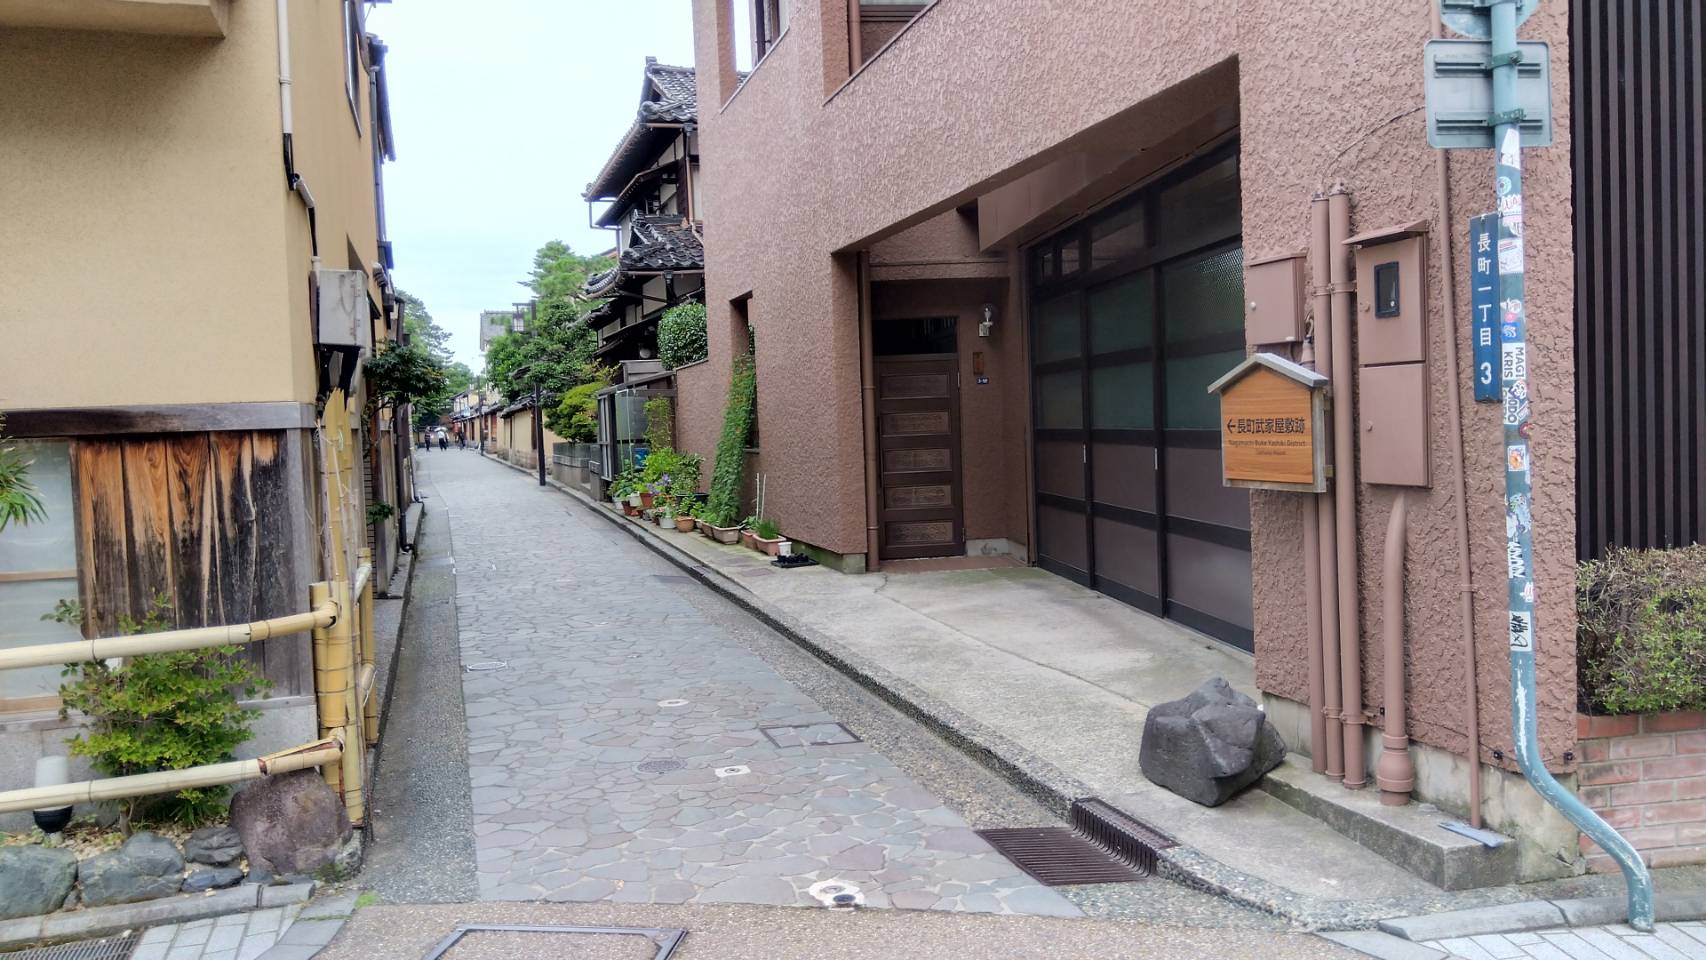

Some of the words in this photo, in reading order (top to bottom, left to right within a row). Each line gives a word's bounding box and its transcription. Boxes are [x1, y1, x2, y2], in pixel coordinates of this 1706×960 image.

[1477, 233, 1492, 346] 長町一丁目
[1480, 362, 1492, 385] 3
[1504, 351, 1514, 378] KRIS
[1238, 418, 1305, 434] 長町武家屋敷跡
